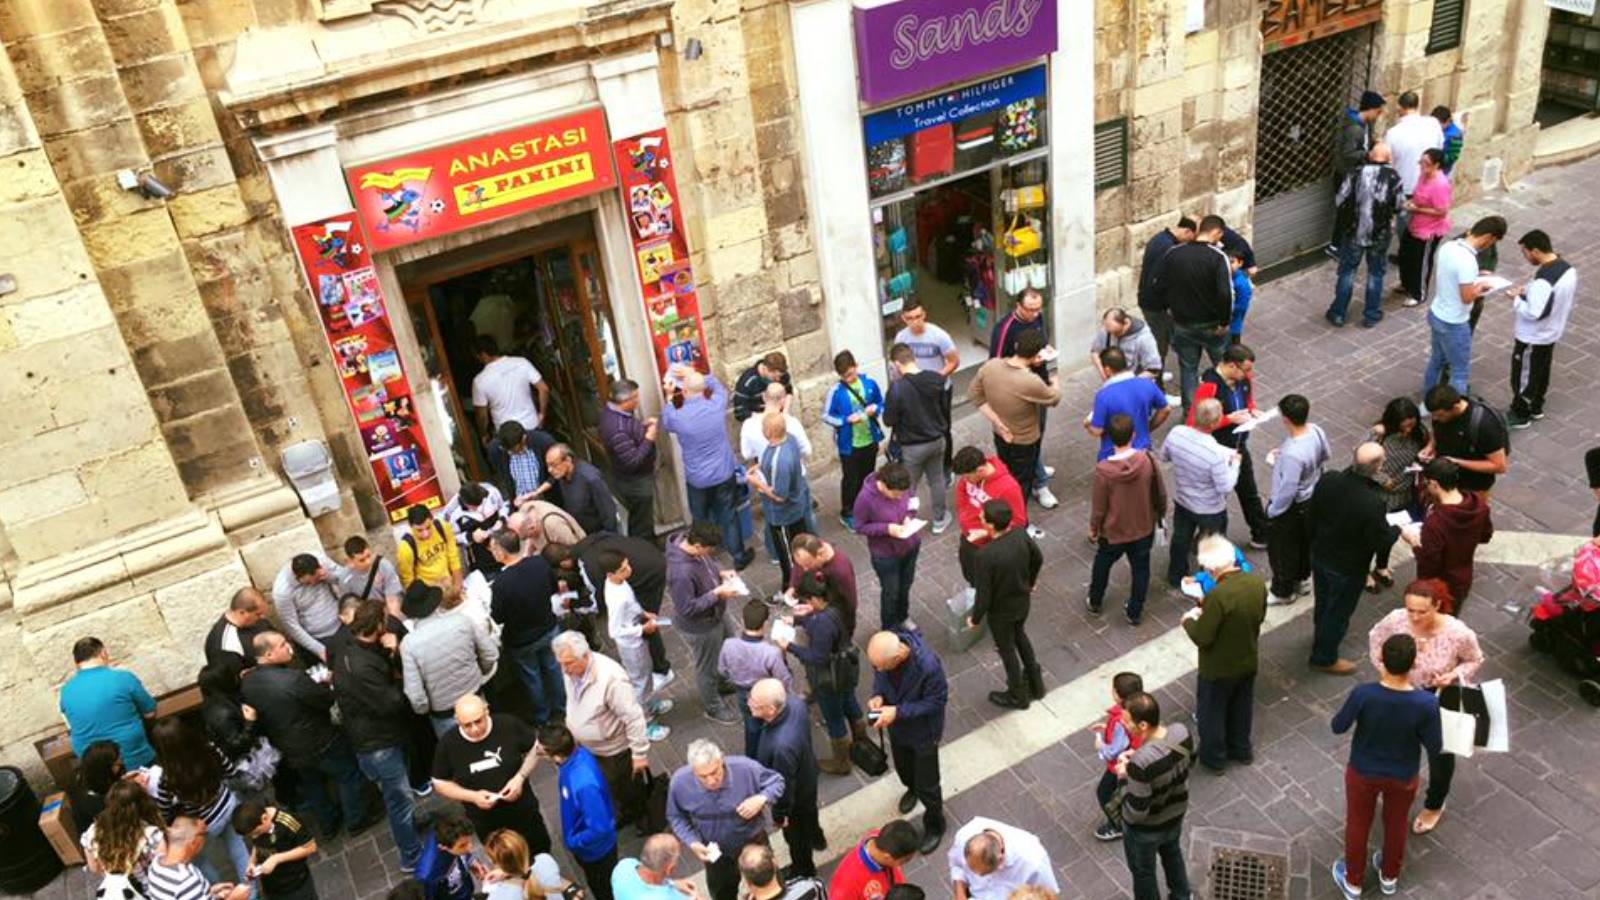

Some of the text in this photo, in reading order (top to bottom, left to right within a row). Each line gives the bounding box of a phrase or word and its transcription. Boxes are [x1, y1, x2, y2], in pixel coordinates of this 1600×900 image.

[890, 0, 1041, 69] Sands
[897, 76, 1014, 118] TOMMY HILFIGER
[913, 98, 1000, 128] Travel Collection
[450, 127, 587, 177] ANASTASI
[495, 158, 585, 193] PANINI
